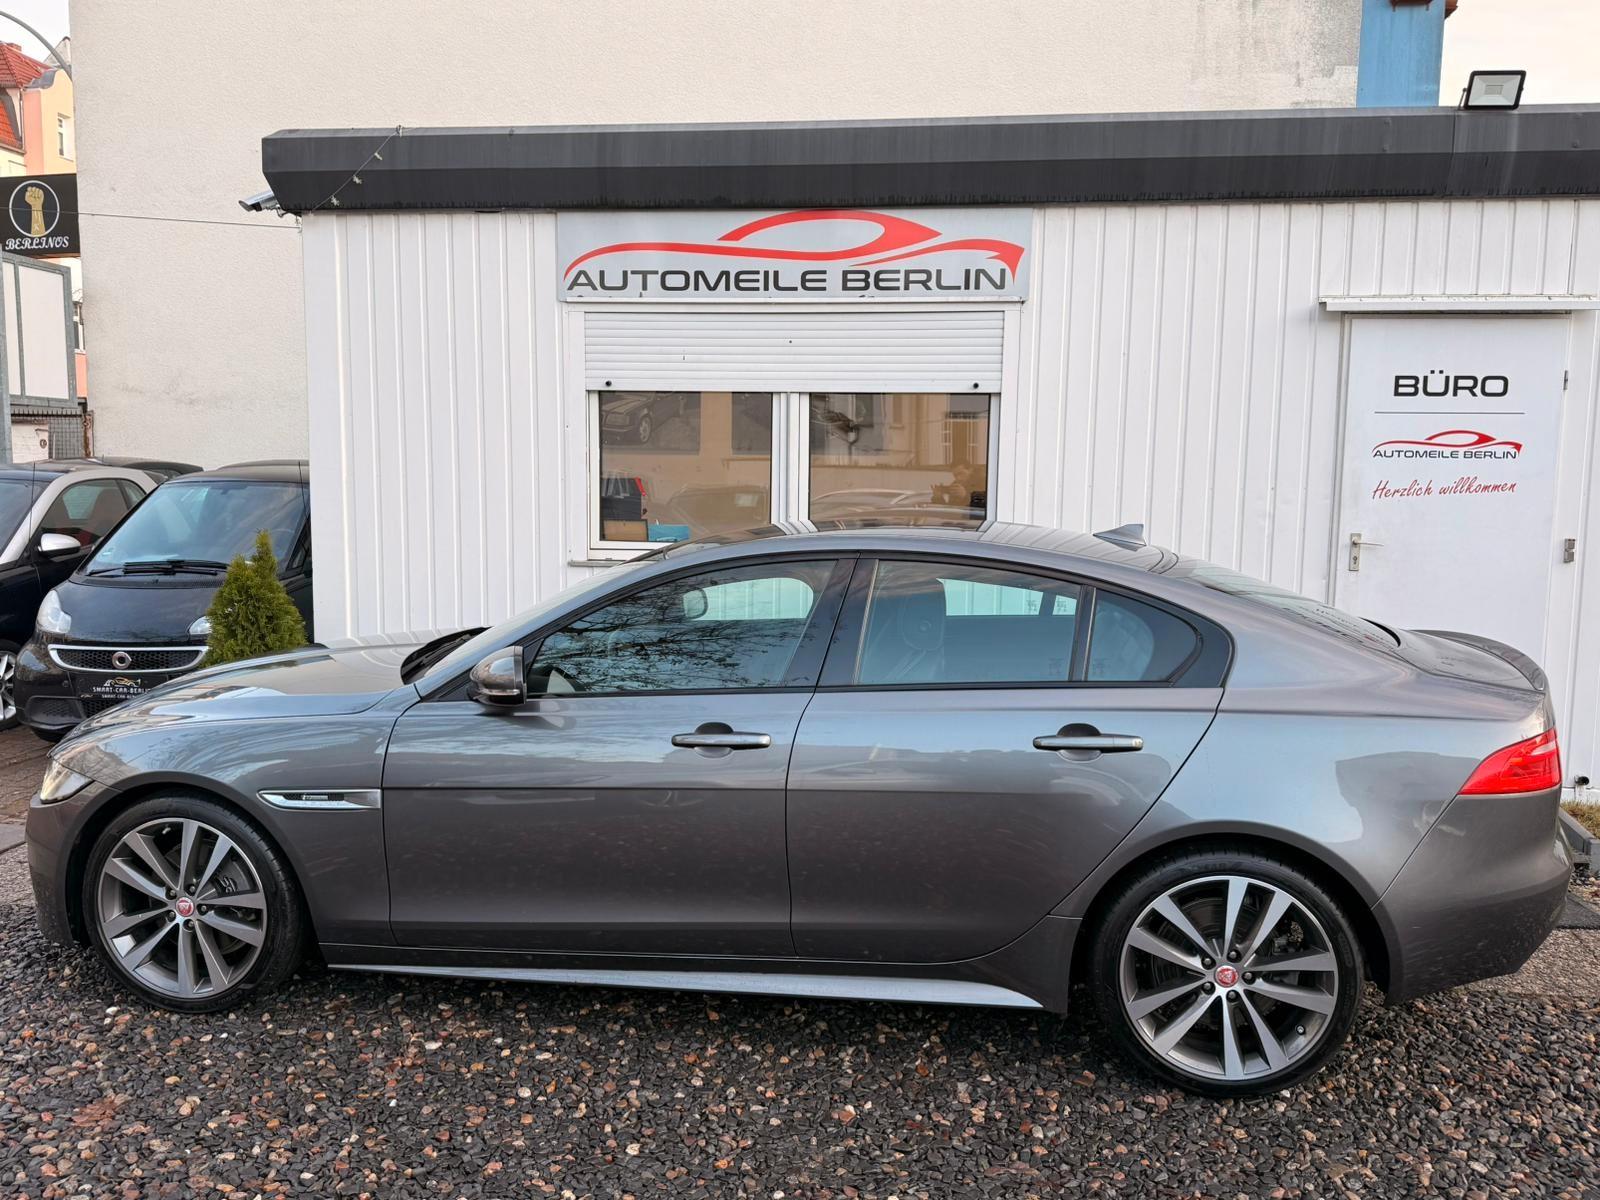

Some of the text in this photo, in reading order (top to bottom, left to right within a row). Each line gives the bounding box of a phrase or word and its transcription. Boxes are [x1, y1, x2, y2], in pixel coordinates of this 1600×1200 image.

[5, 236, 70, 250] BERLINOS
[567, 268, 1007, 292] AUTOMEILE BERLIN
[1394, 370, 1509, 397] BÜRO
[1373, 450, 1517, 459] AUTOMEILE BERLIN
[1372, 476, 1517, 500] Herzlich willkommen
